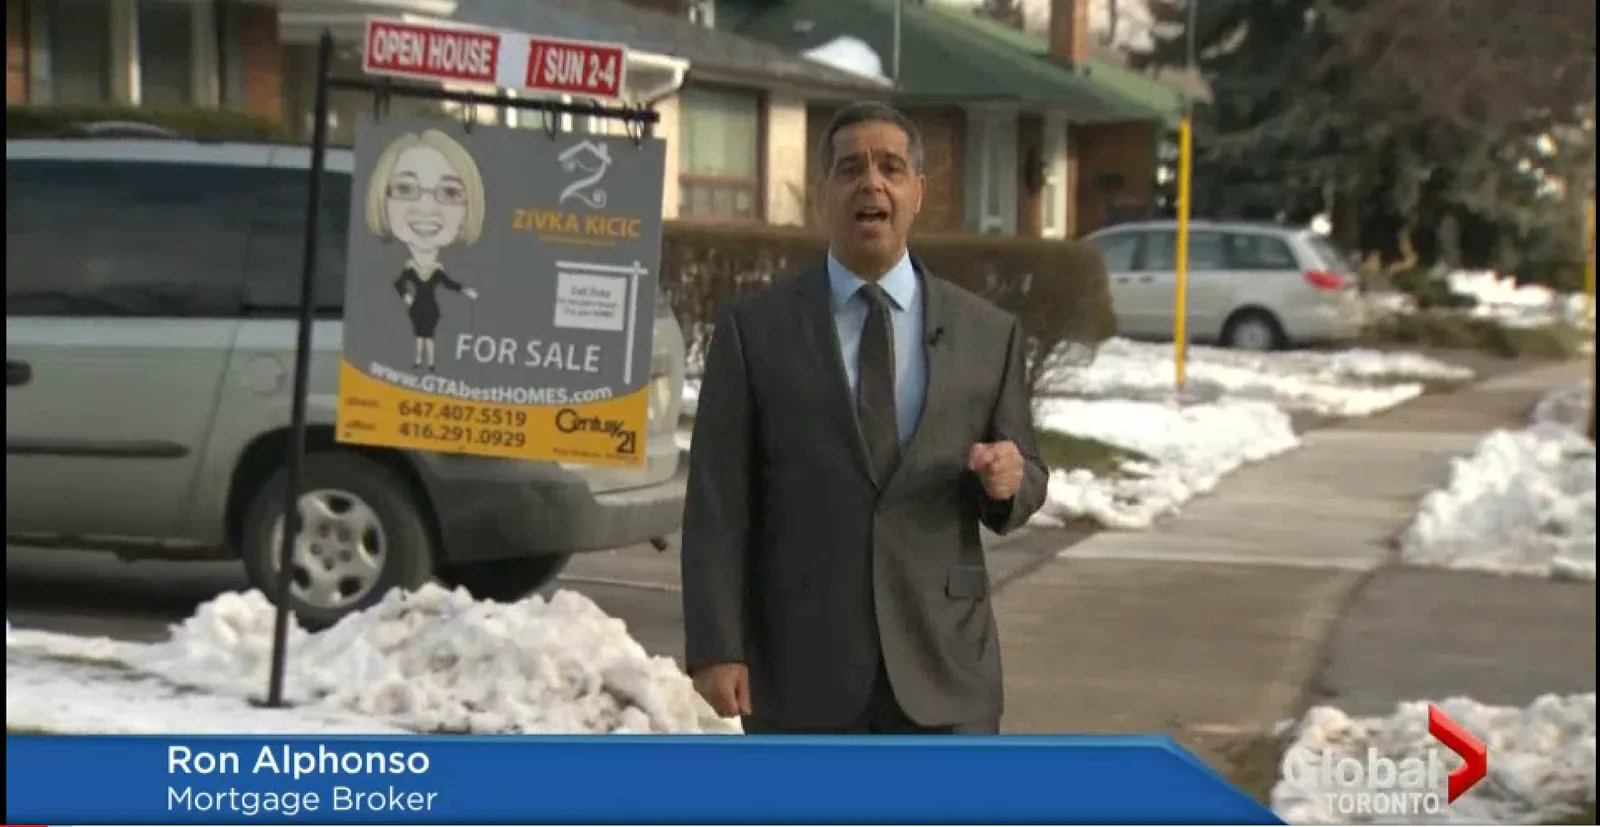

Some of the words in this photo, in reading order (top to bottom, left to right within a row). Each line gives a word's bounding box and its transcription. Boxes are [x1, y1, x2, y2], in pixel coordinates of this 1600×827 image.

[374, 27, 425, 66] OPEN
[427, 33, 493, 75] HOUSE
[588, 54, 616, 88] 2-4
[512, 208, 579, 232] ZIVKA
[585, 214, 641, 238] KICIC
[456, 334, 517, 366] FOR
[525, 340, 600, 373] SALE
[370, 361, 613, 404] www.GTAbestHOMES.com
[399, 400, 527, 427] 647.407.5519
[398, 422, 526, 447] 416.291.0929
[617, 430, 636, 454] 21
